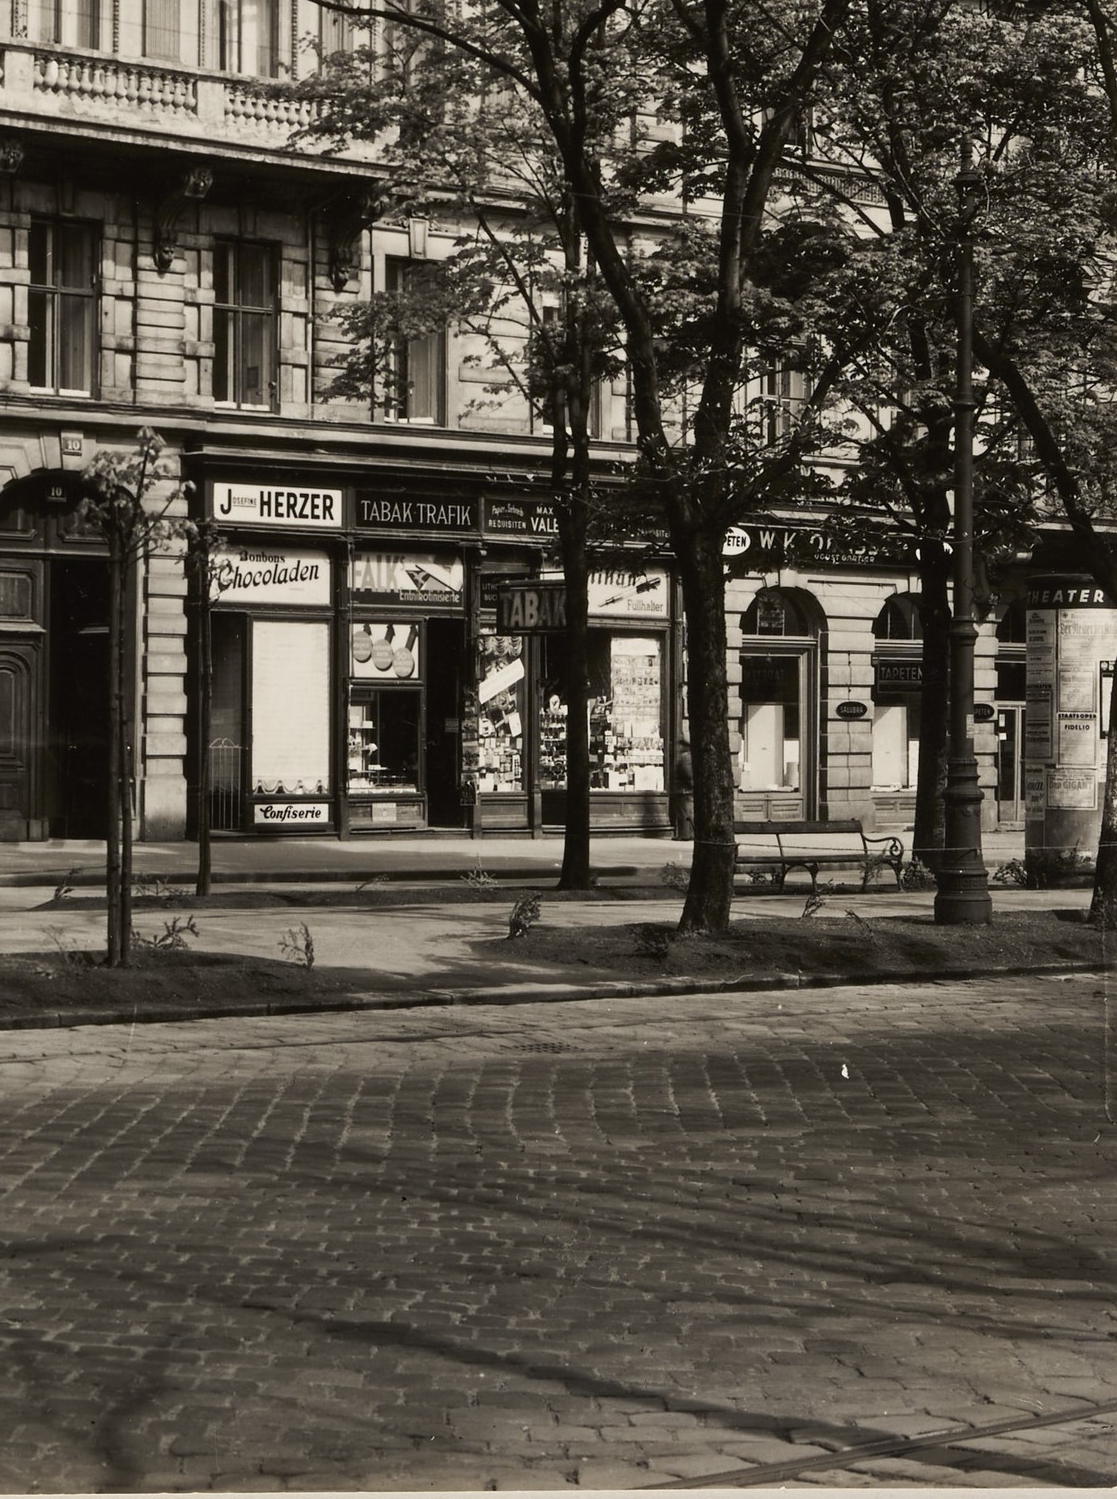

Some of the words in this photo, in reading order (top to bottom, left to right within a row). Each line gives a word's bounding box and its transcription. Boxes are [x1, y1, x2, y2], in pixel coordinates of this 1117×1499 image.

[66, 439, 81, 451] 10
[50, 486, 63, 497] 10
[260, 490, 335, 521] HERZER
[536, 506, 554, 516] MAX
[488, 519, 527, 530] REQUISITEN
[240, 551, 286, 564] Bonbons
[217, 558, 320, 592] Chocoladen
[499, 590, 568, 628] TABAK
[259, 805, 323, 823] Confiserie
